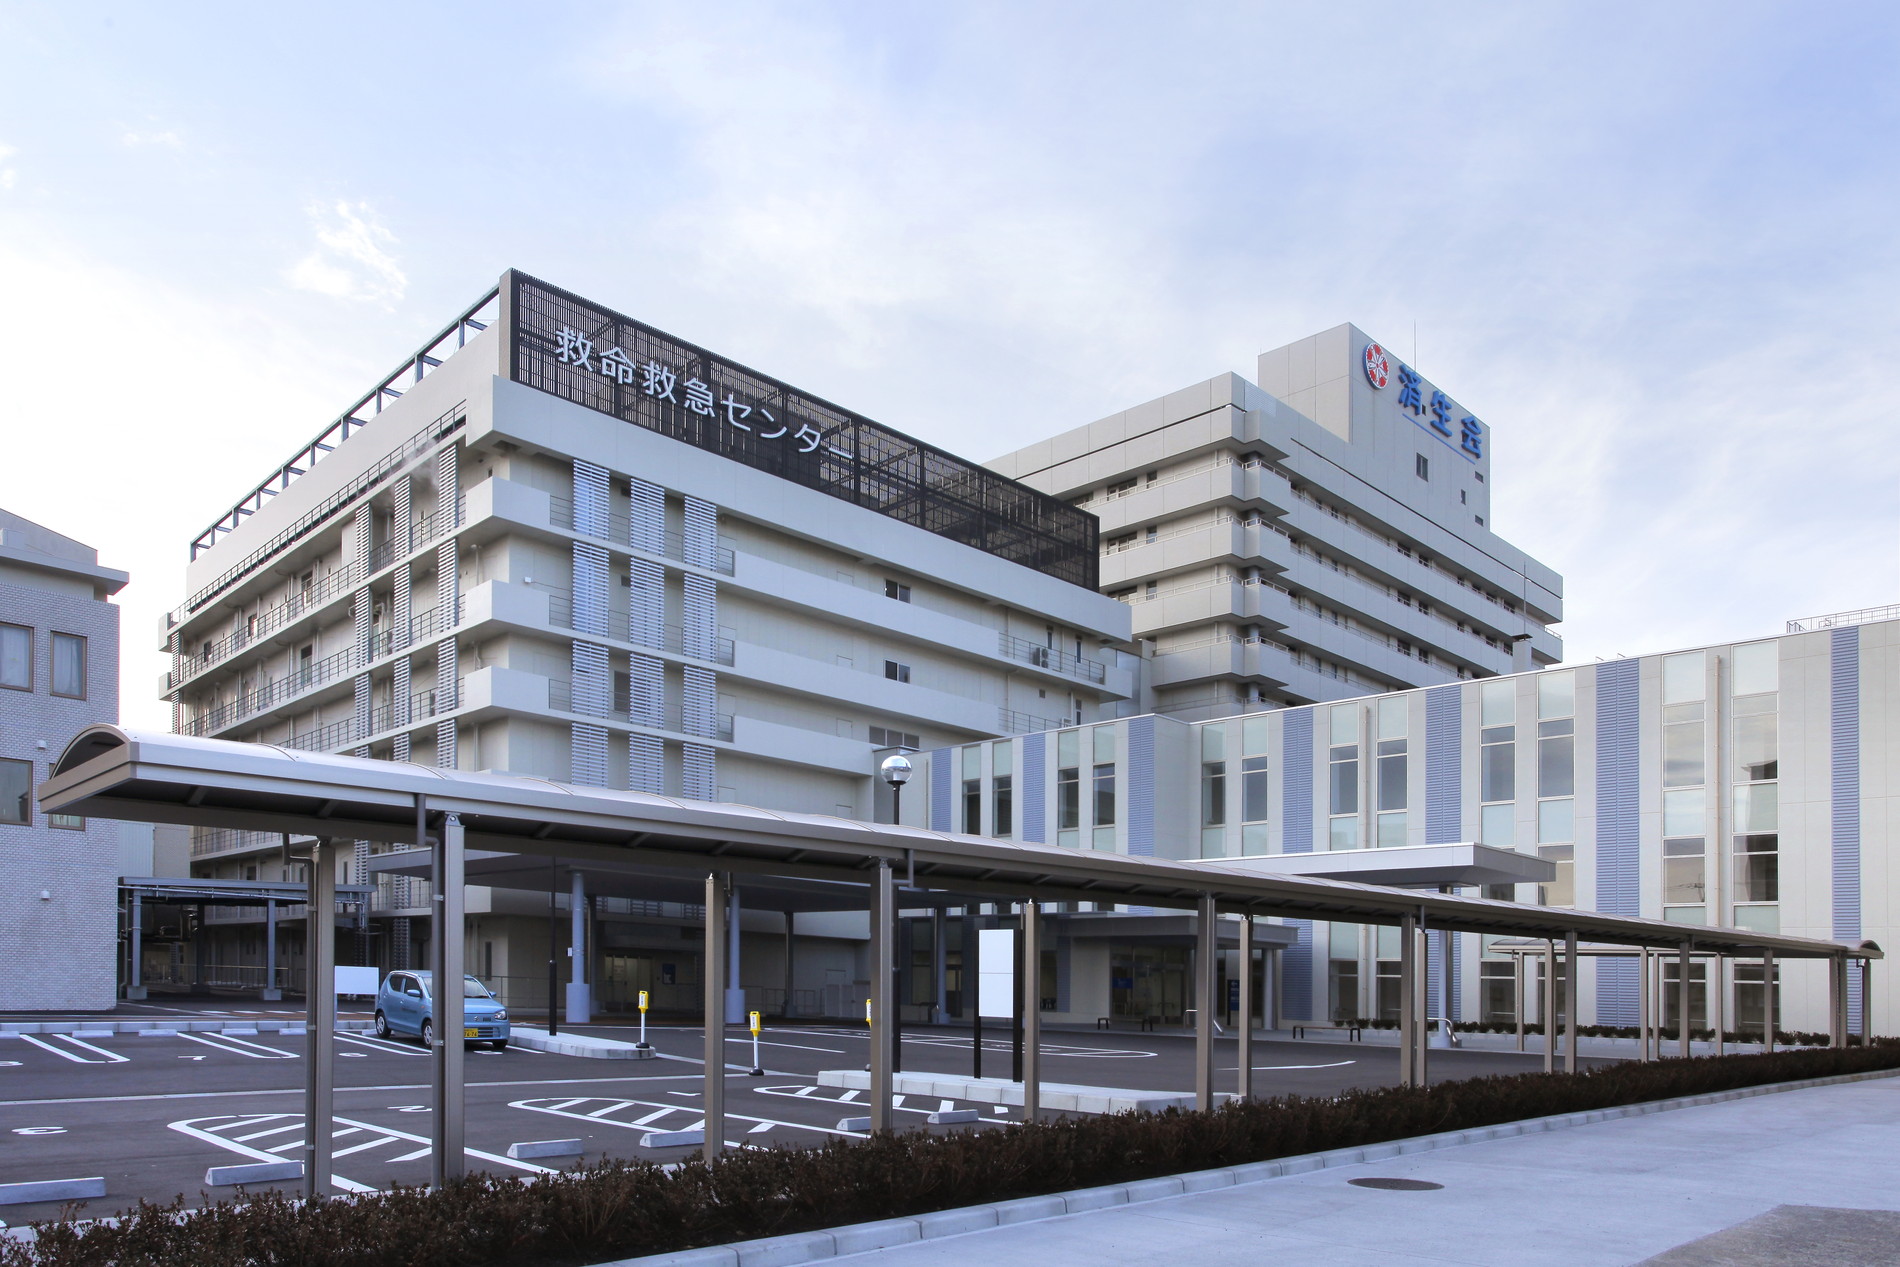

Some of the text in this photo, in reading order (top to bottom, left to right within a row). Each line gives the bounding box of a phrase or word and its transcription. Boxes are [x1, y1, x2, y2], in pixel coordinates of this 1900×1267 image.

[554, 325, 854, 460] 救命救急センター
[1398, 364, 1482, 459] 済生会
[11, 1126, 68, 1136] 3
